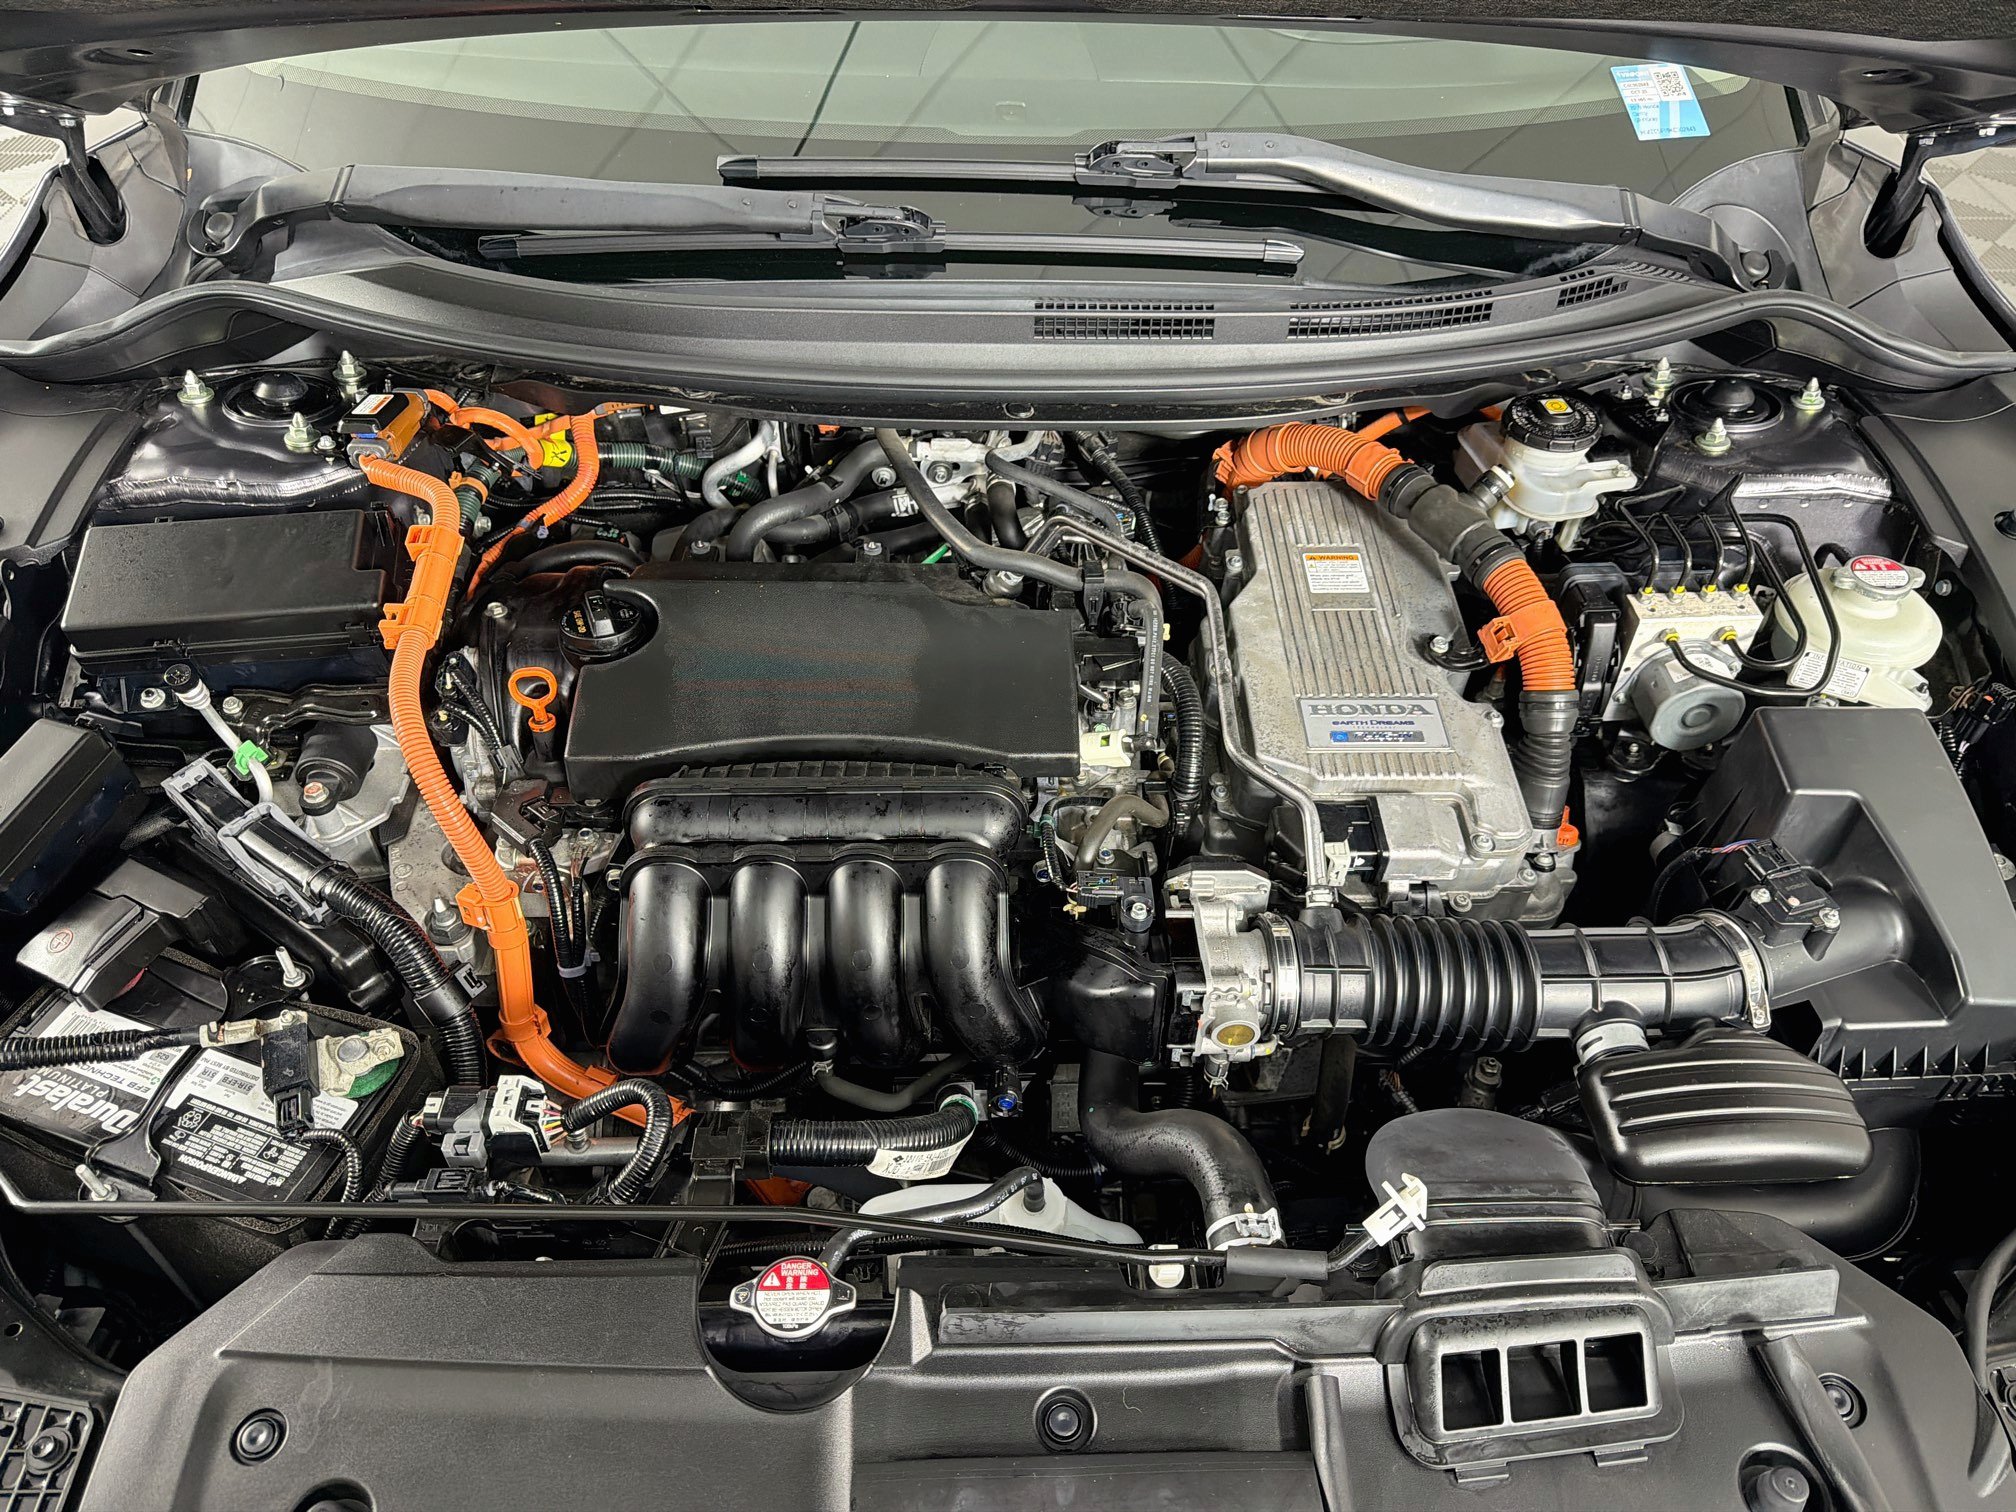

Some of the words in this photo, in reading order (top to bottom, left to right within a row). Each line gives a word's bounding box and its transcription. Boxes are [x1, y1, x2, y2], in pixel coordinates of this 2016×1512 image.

[1308, 704, 1434, 716] HONDA
[155, 1051, 169, 1060] 625
[200, 1068, 217, 1079] 51R
[37, 1066, 110, 1098] PLATINUM
[127, 1080, 152, 1094] EFB
[220, 1075, 253, 1091] 51R-EFB
[13, 1074, 140, 1134] Duralast
[178, 1155, 242, 1183] DANGER/POISON
[781, 1262, 812, 1270] DANGER
[781, 1269, 819, 1277] WARNUNG
